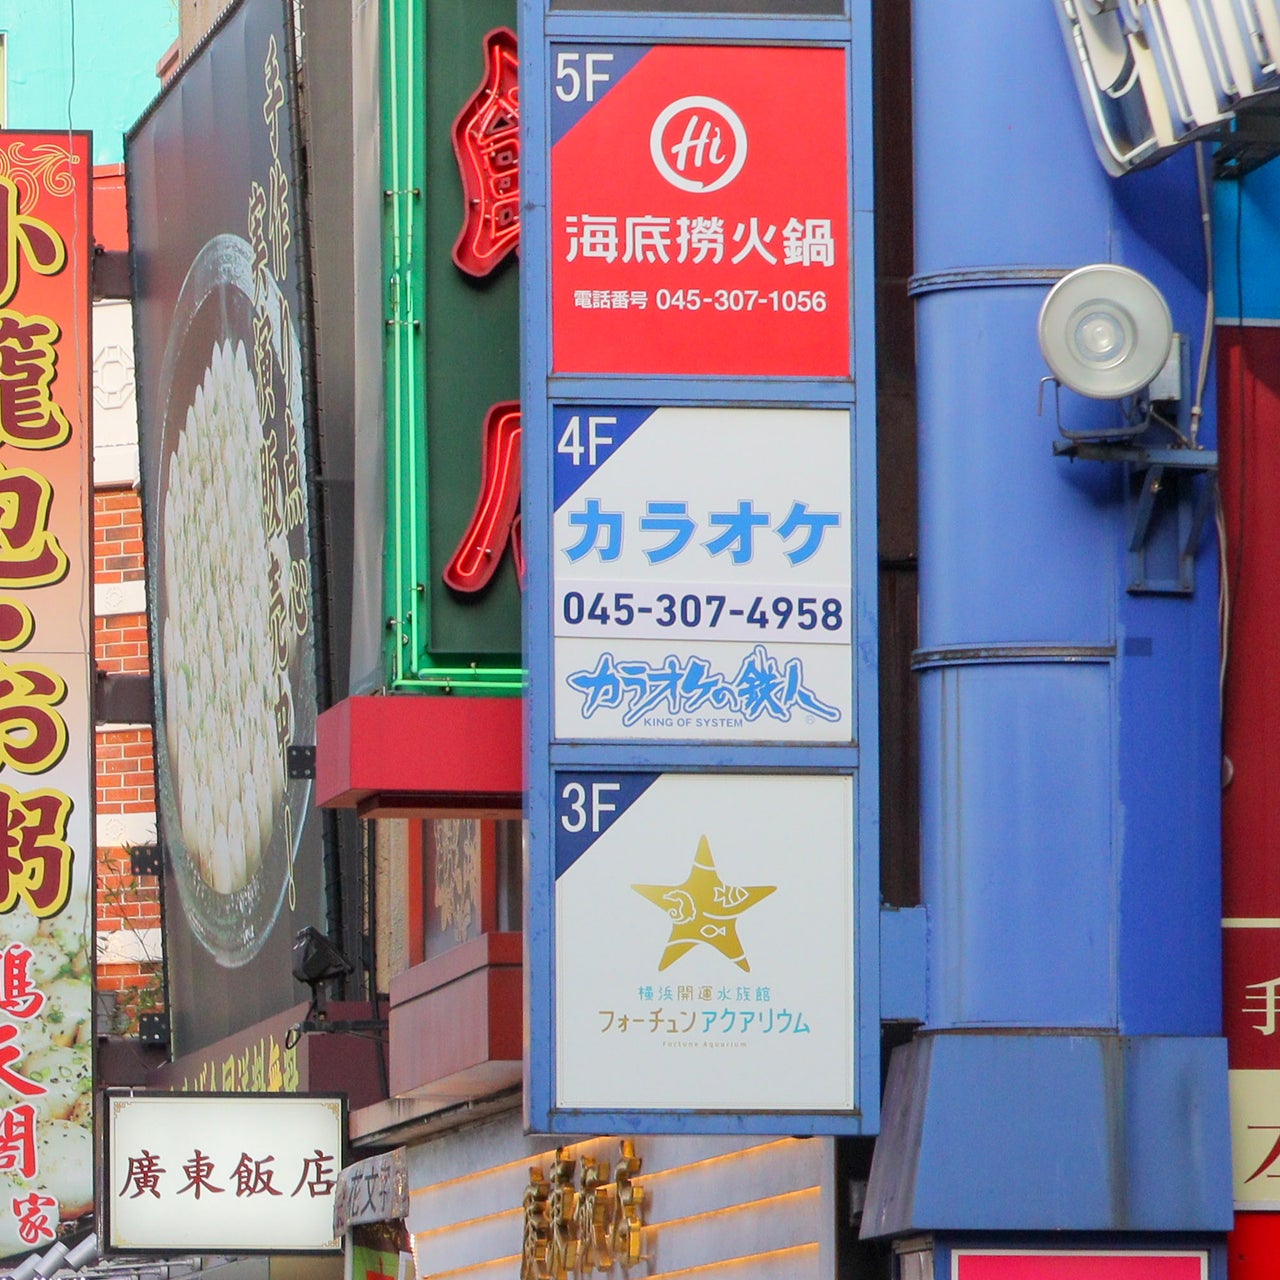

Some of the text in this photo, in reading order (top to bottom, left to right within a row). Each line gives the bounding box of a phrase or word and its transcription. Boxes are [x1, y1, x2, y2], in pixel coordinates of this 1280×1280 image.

[555, 52, 614, 102] 5F
[671, 114, 726, 171] Hi
[565, 214, 835, 267] 海底撈火鍋
[573, 288, 827, 312] 電話番号 045-307-1056
[557, 416, 618, 466] 4F
[561, 498, 841, 567] カラオケ
[563, 590, 843, 631] 045-307-4958
[566, 645, 842, 727] カラオケの鉄人
[644, 718, 743, 729] KING OF SYSTEM
[561, 782, 620, 833] 3F
[638, 985, 771, 1002] 横浜開運水族館
[118, 1149, 338, 1200] 廣東飯店
